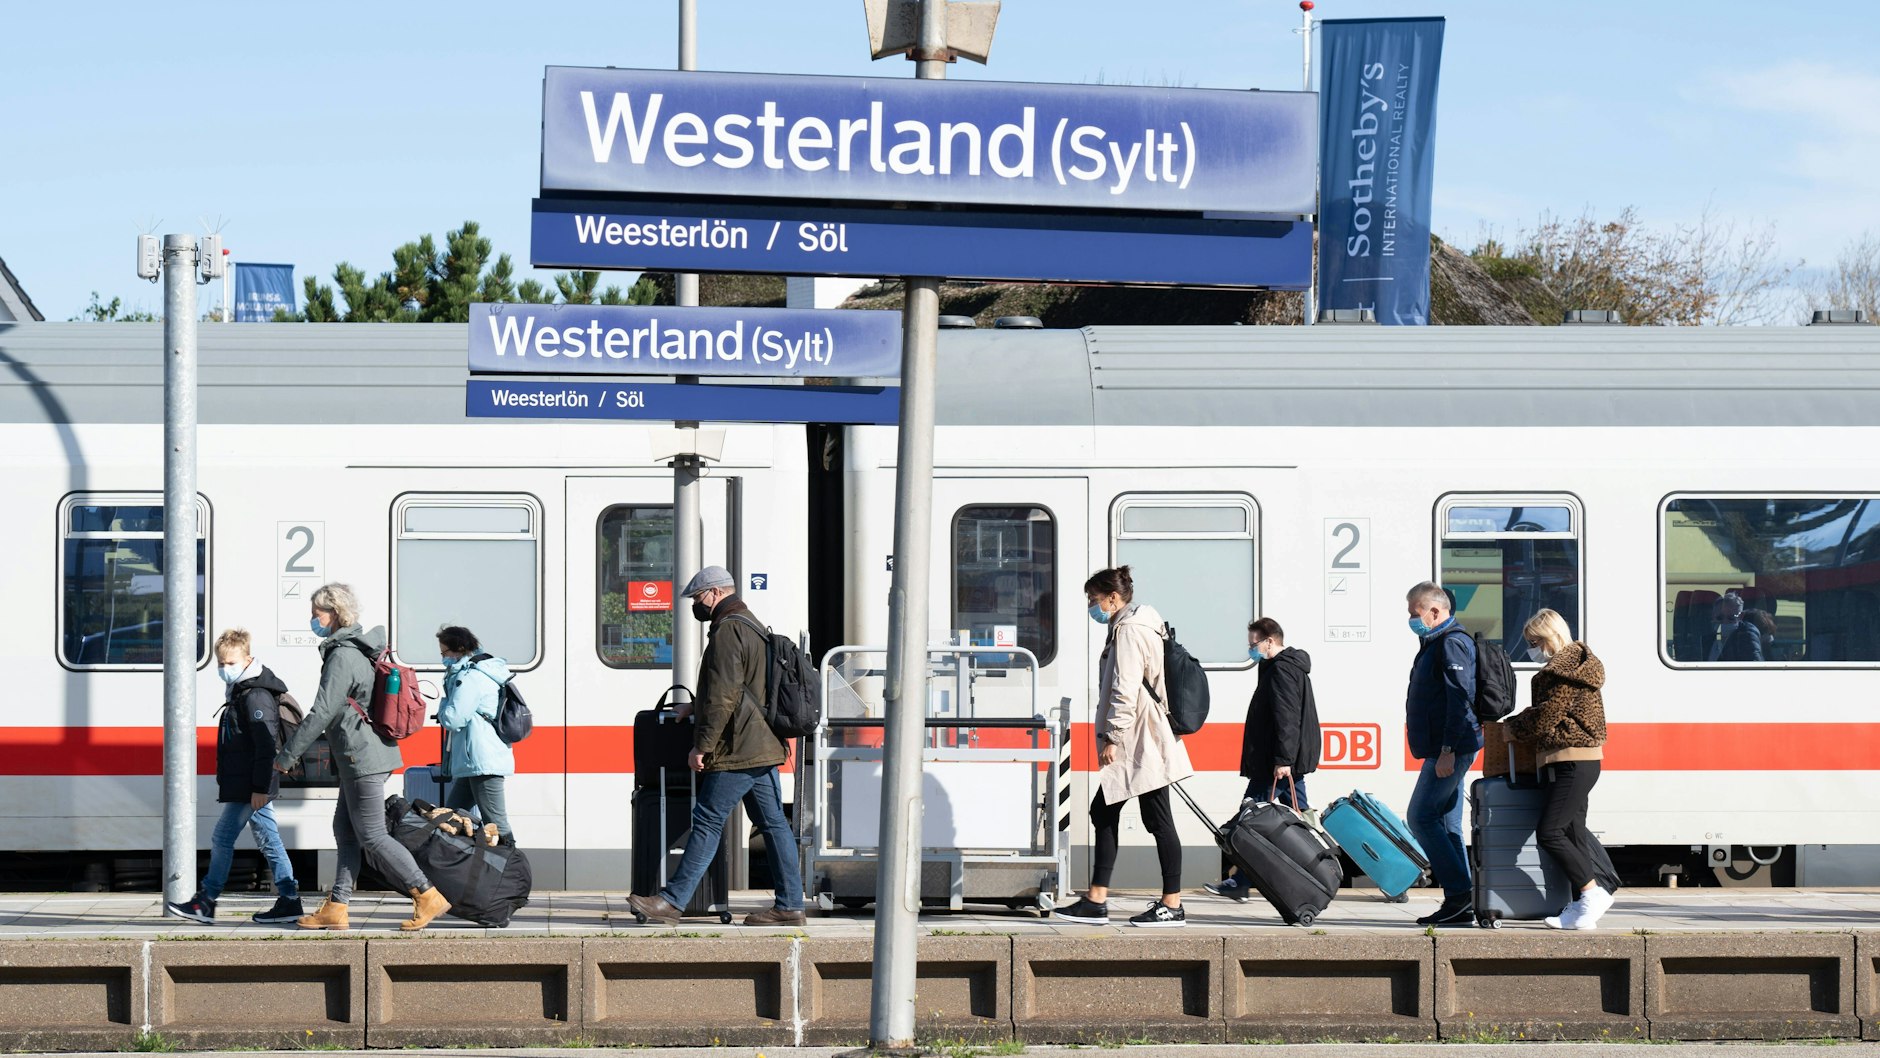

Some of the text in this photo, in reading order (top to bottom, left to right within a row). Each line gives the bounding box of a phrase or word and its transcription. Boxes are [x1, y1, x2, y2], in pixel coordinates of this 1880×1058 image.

[580, 91, 1196, 195] Westerland (Sylt)
[1347, 61, 1388, 258] Sotheby's
[1382, 62, 1410, 257] INTERNATIONAL REALTY
[575, 215, 849, 253] Weesterlön / Söl
[488, 315, 834, 370] Westerland (Sylt)
[491, 389, 589, 407] Weesterlön
[616, 390, 645, 408] Söl
[285, 525, 315, 572] 2
[1331, 522, 1361, 569] 2
[997, 630, 1004, 641] 8
[1323, 730, 1374, 762] DB
